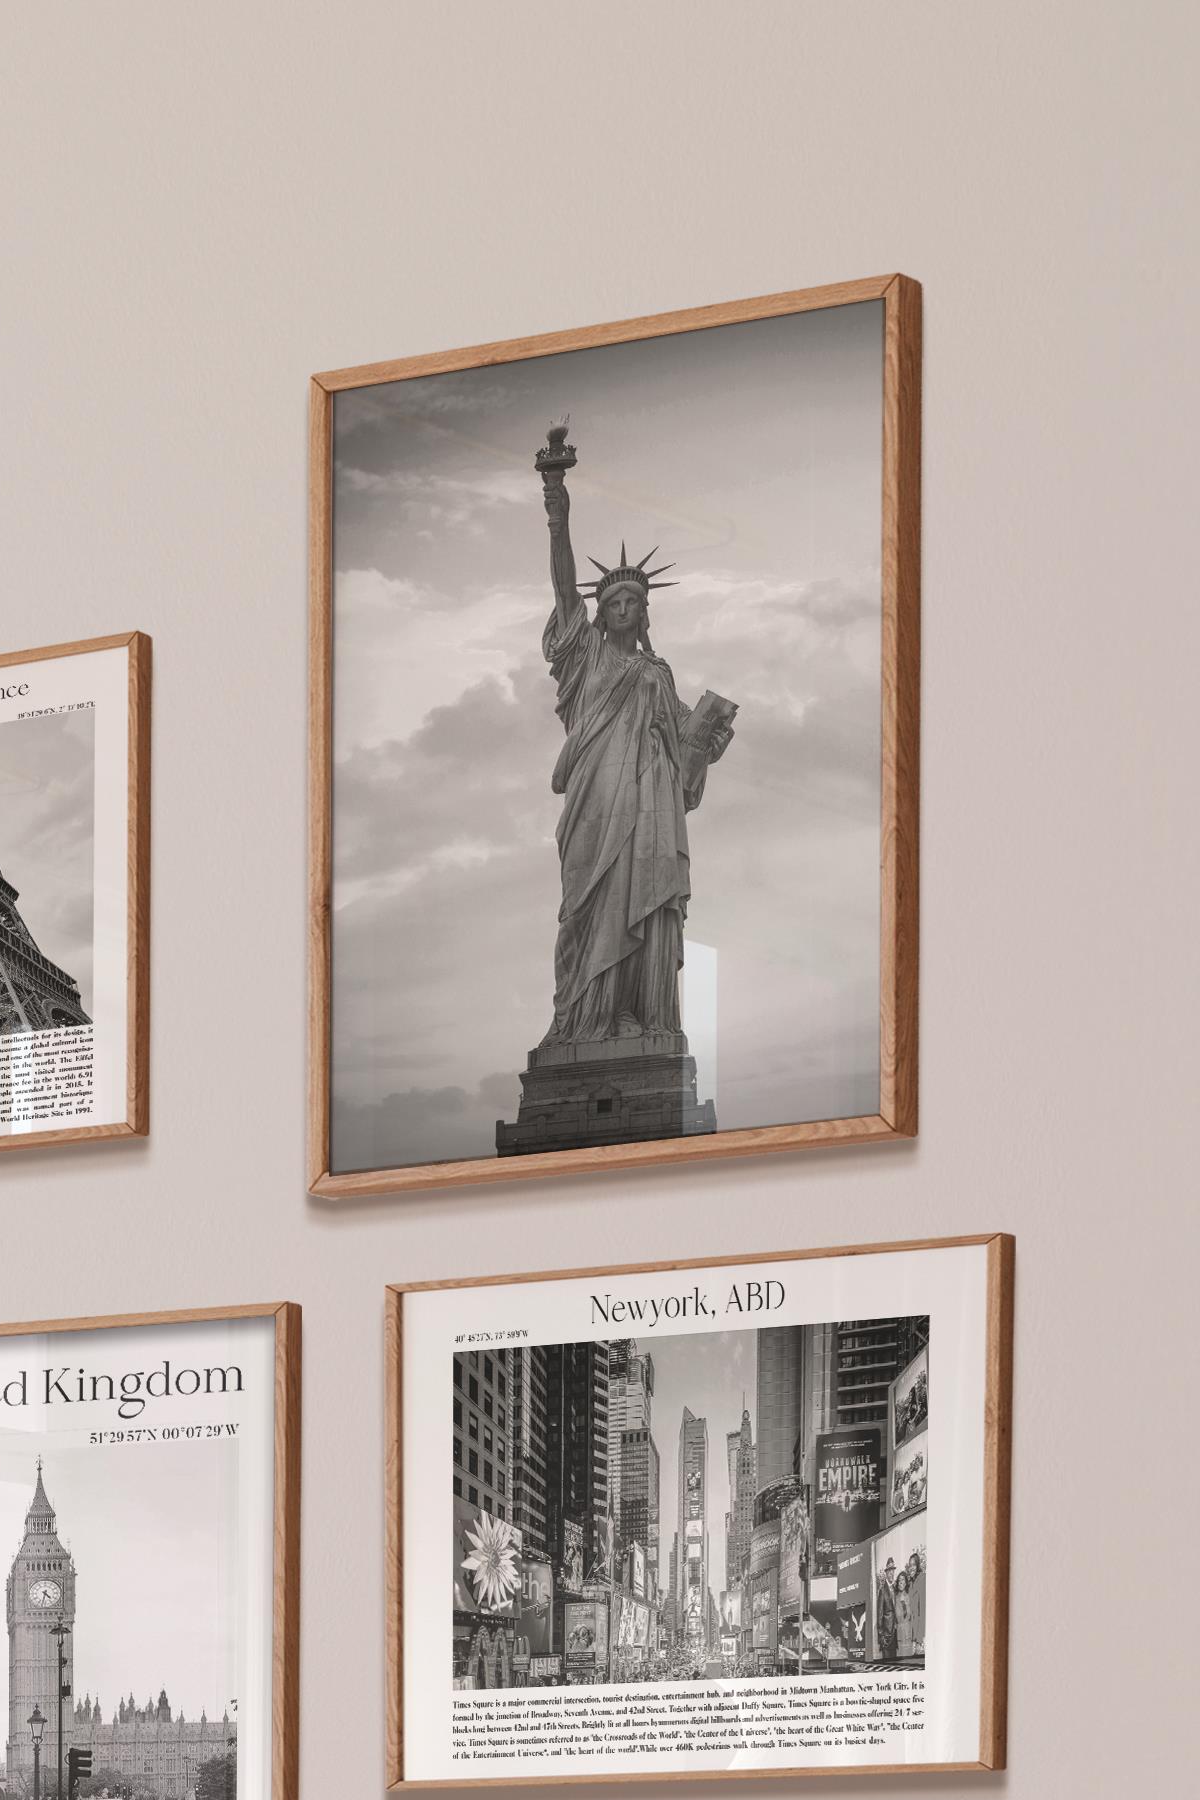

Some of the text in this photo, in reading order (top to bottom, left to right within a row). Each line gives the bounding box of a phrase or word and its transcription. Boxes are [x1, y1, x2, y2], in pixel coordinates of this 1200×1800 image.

[590, 1280, 785, 1327] Newyork, ABD
[42, 1359, 245, 1420] Kingdom
[819, 1464, 877, 1491] EMPIRE
[453, 1700, 472, 1709] Times
[472, 1700, 495, 1710] Square
[495, 1699, 501, 1708] is
[507, 1698, 526, 1708] major
[527, 1696, 562, 1707] commercial
[602, 1694, 624, 1703] tourist
